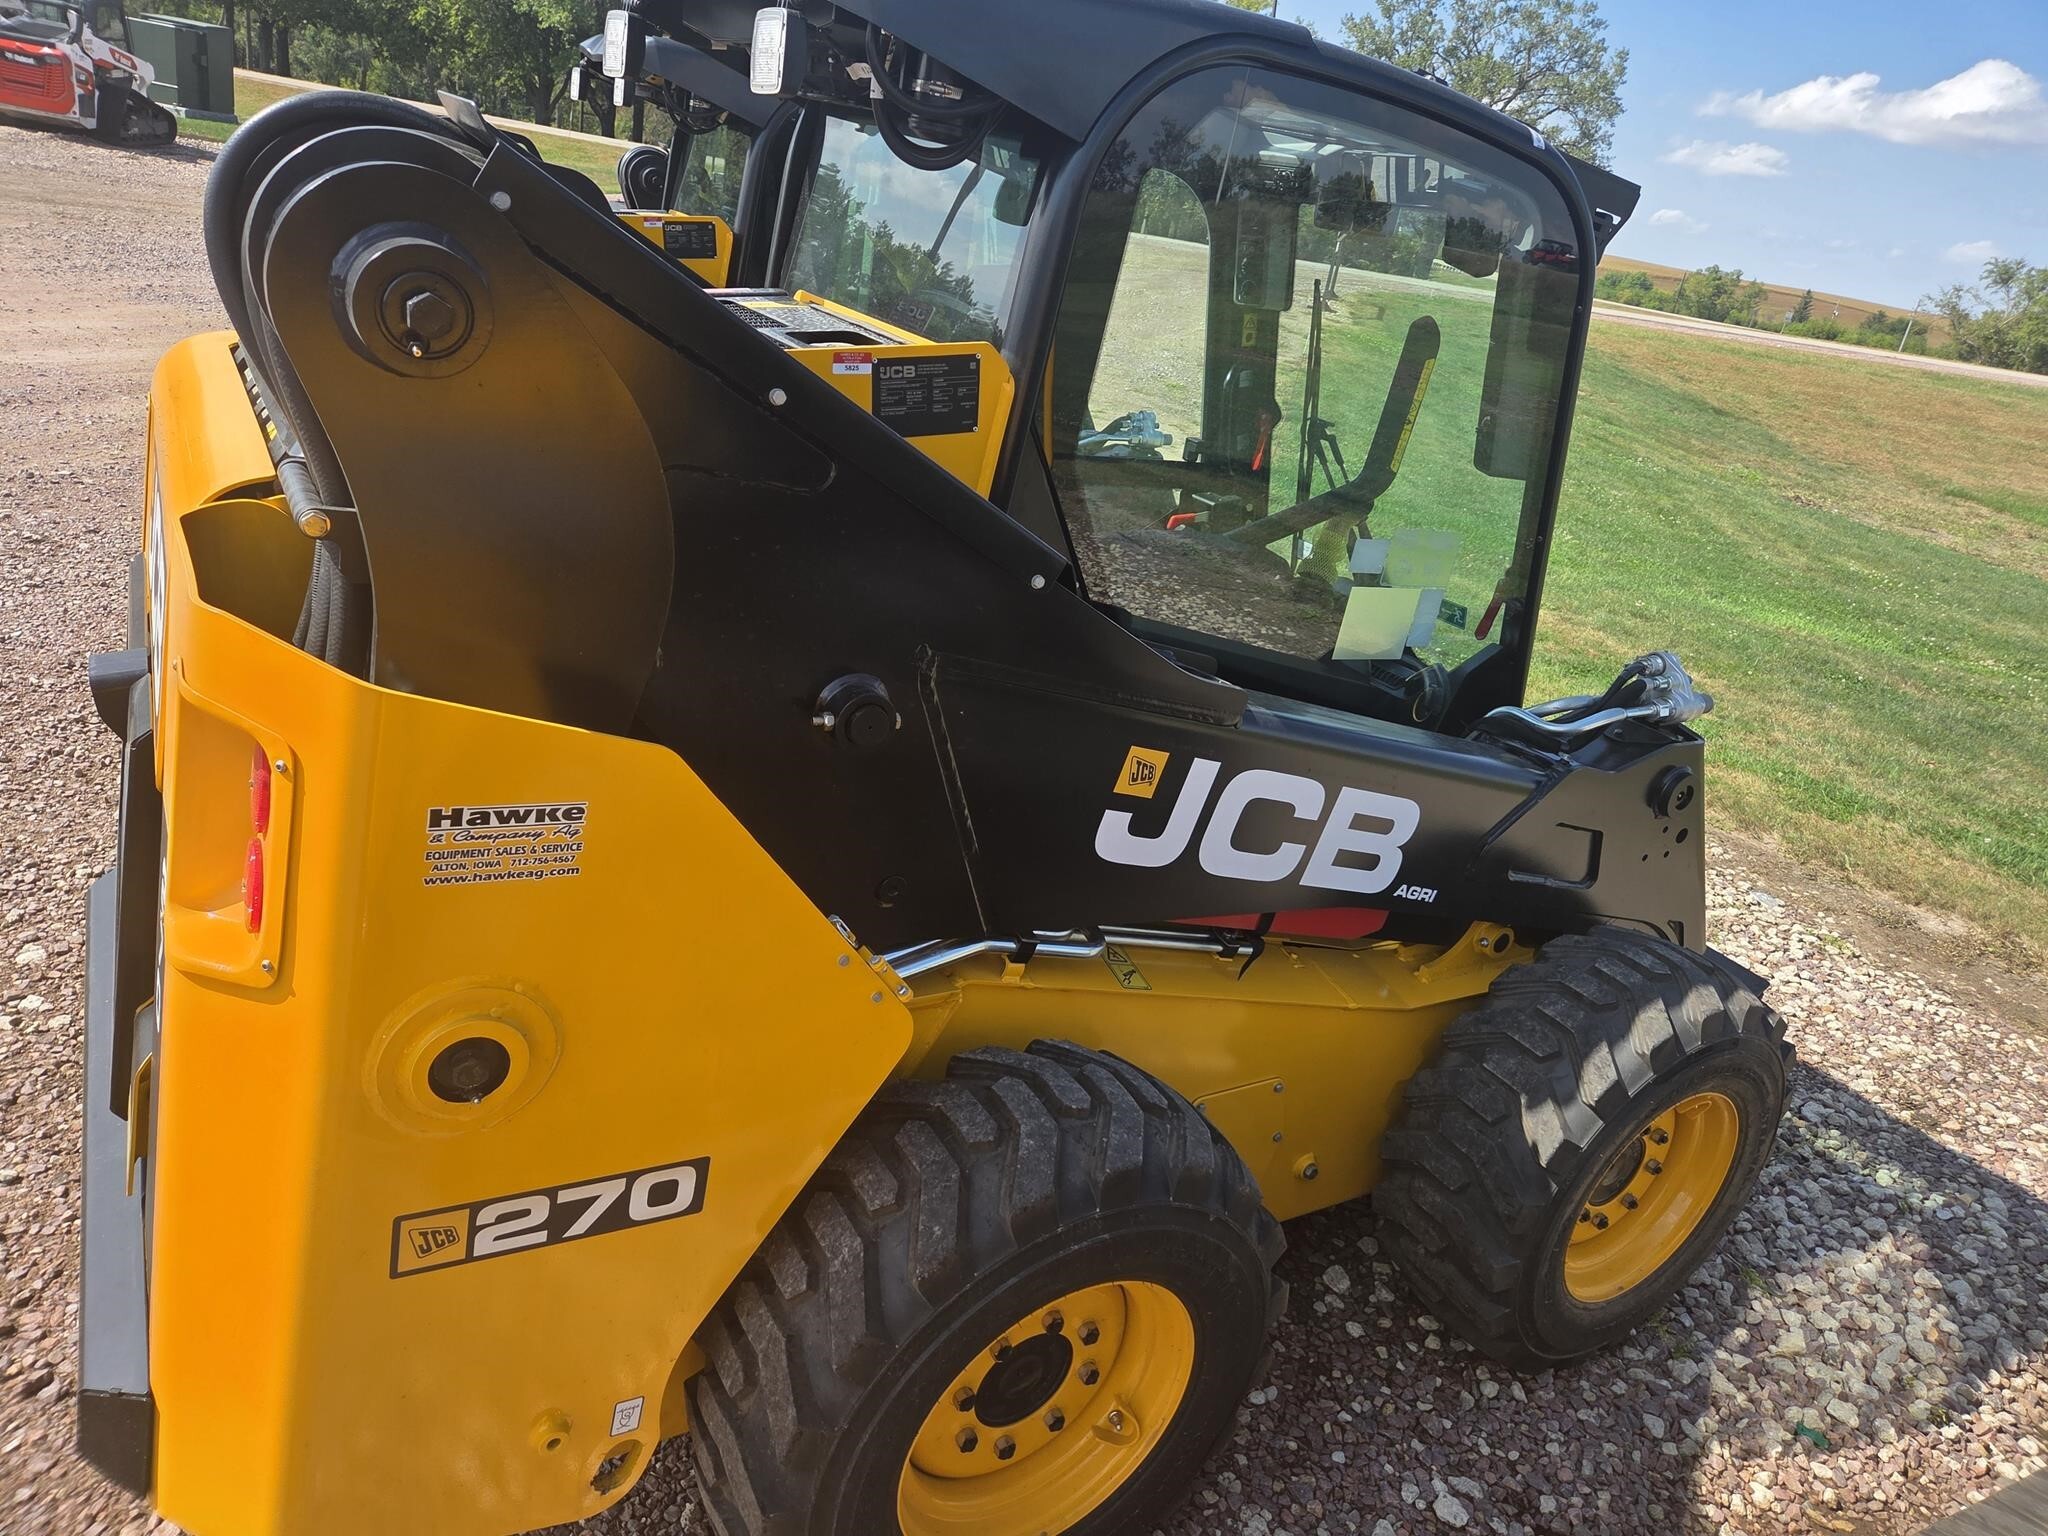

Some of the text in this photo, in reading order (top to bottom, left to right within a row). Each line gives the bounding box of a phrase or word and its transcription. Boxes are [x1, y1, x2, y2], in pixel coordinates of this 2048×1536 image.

[880, 365, 916, 379] JCB
[1130, 759, 1155, 782] JCB
[428, 805, 586, 828] Hawke
[1095, 757, 1420, 893] JCB
[429, 825, 582, 844] & Company Ag
[425, 842, 583, 861] EQUIPMENT SALES & SERVICE
[431, 855, 576, 872] ALTON, IOWA 712-756-4567
[423, 867, 580, 885] www.hawkeag.com
[1392, 884, 1438, 902] AGRI
[473, 1166, 697, 1257] 270
[417, 1226, 458, 1254] JCB
